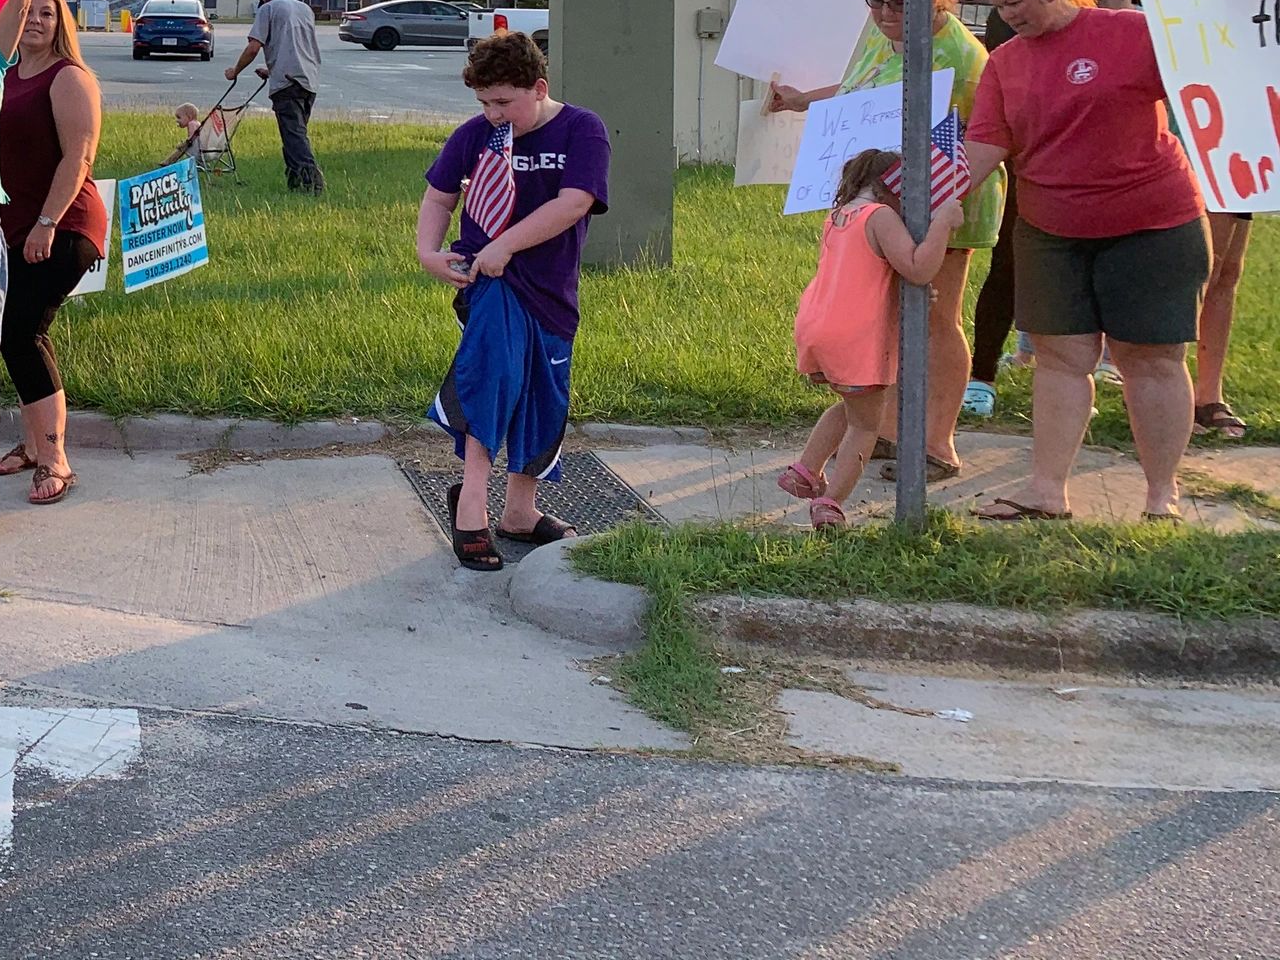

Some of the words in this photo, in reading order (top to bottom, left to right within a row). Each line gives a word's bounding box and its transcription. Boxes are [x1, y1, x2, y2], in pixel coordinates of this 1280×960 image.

[821, 106, 851, 137] WE
[512, 153, 567, 172] GLES
[130, 172, 179, 206] DANCE
[796, 185, 814, 201] OF
[139, 183, 193, 229] Infinity
[128, 227, 167, 250] REGISTER
[167, 220, 185, 236] NOW
